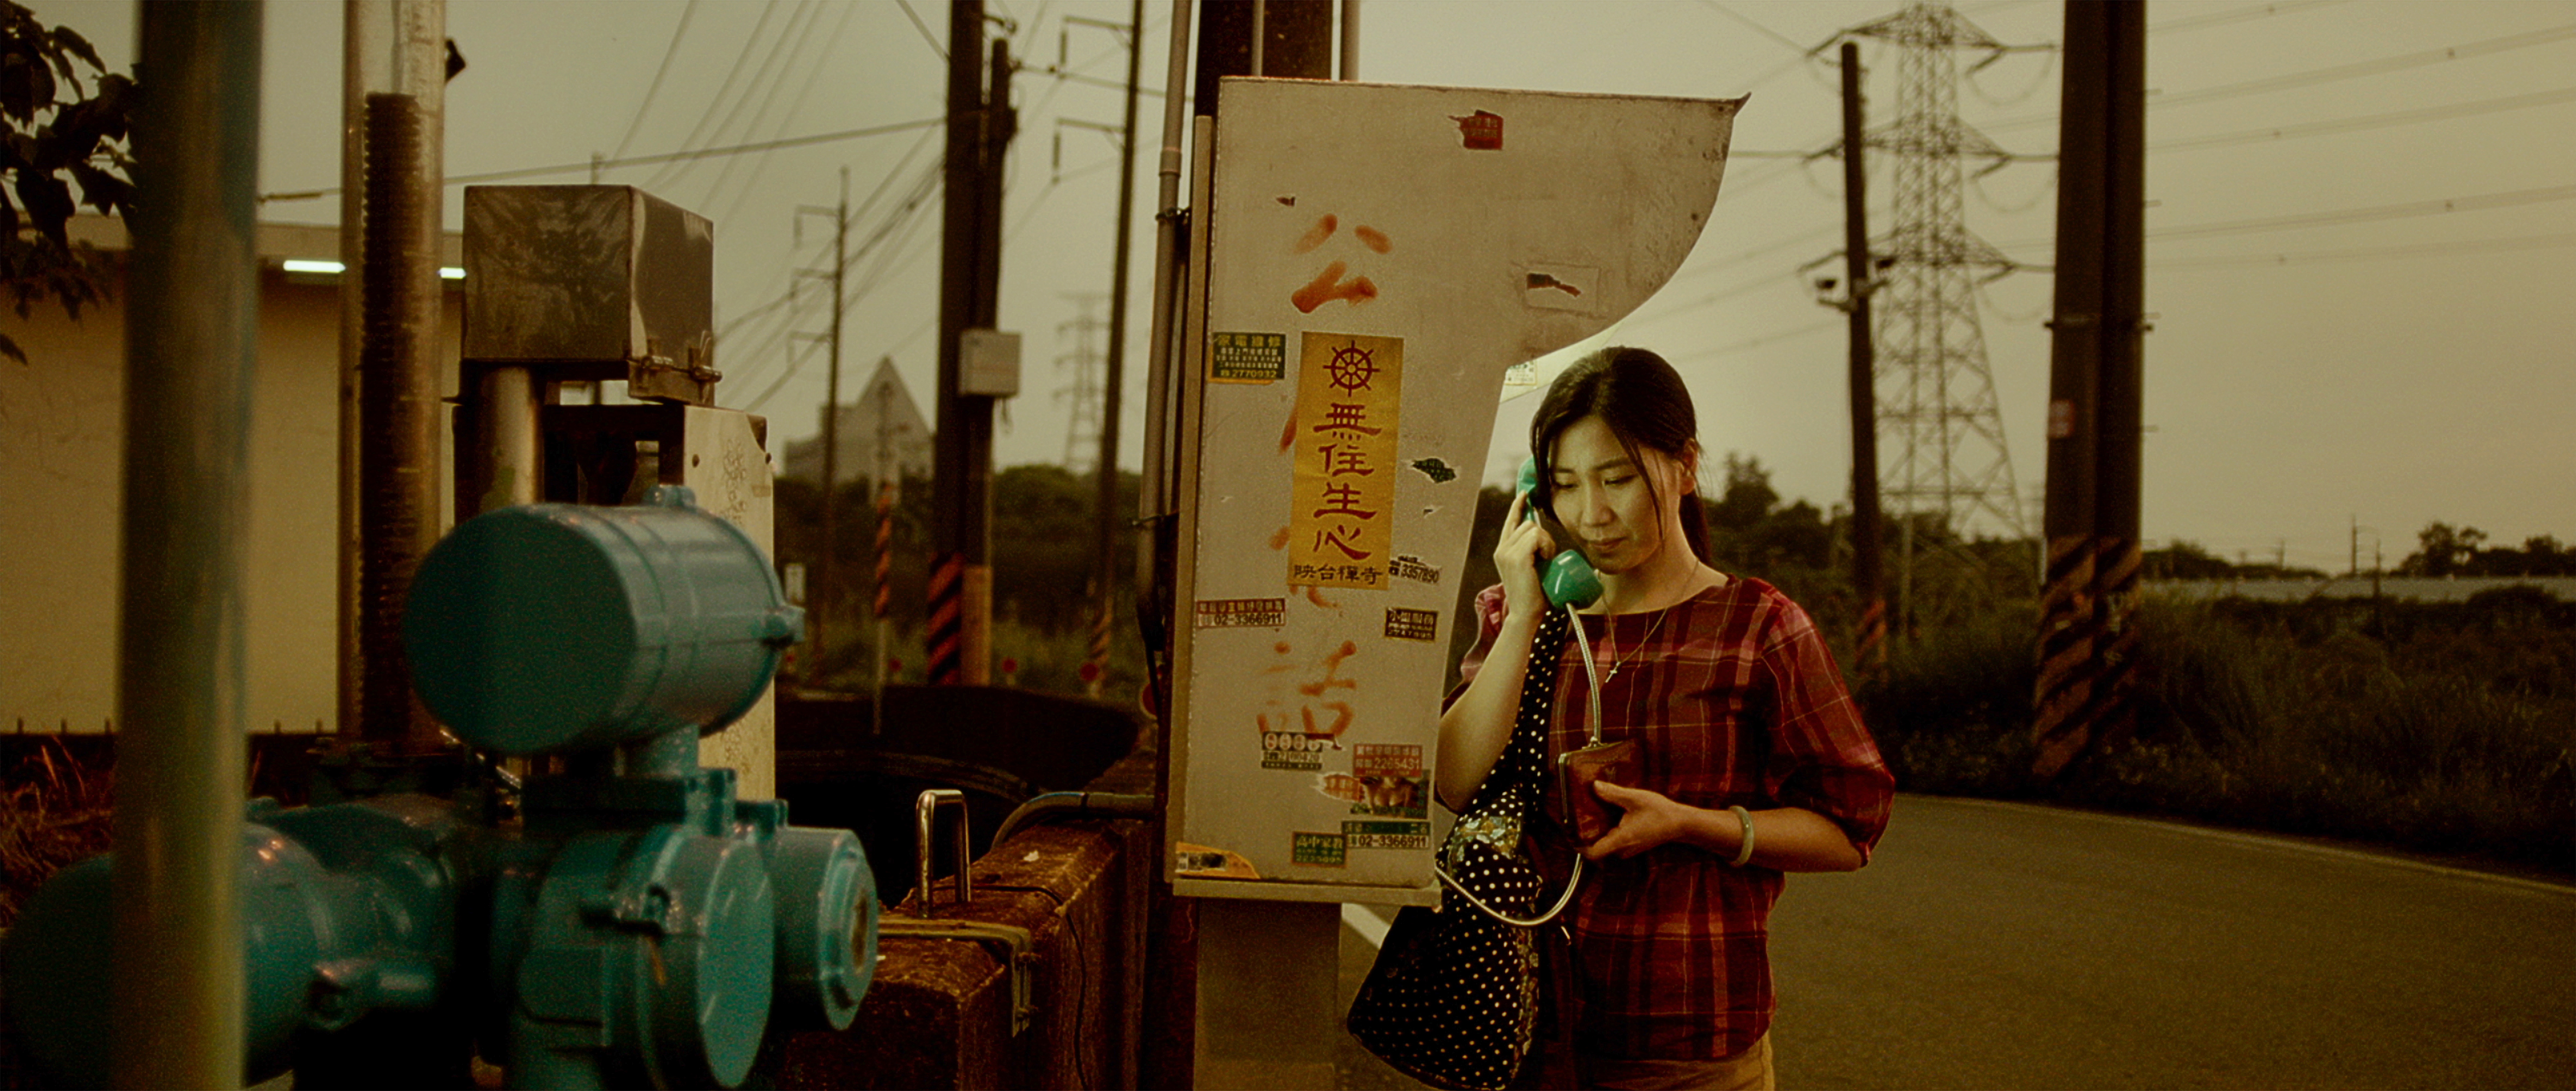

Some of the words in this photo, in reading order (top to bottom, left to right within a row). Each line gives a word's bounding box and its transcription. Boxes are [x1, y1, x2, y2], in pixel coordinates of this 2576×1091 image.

[1313, 403, 1382, 560] 無住生心
[1214, 613, 1281, 626] 02-3366911
[1358, 835, 1426, 848] 02-3366911
